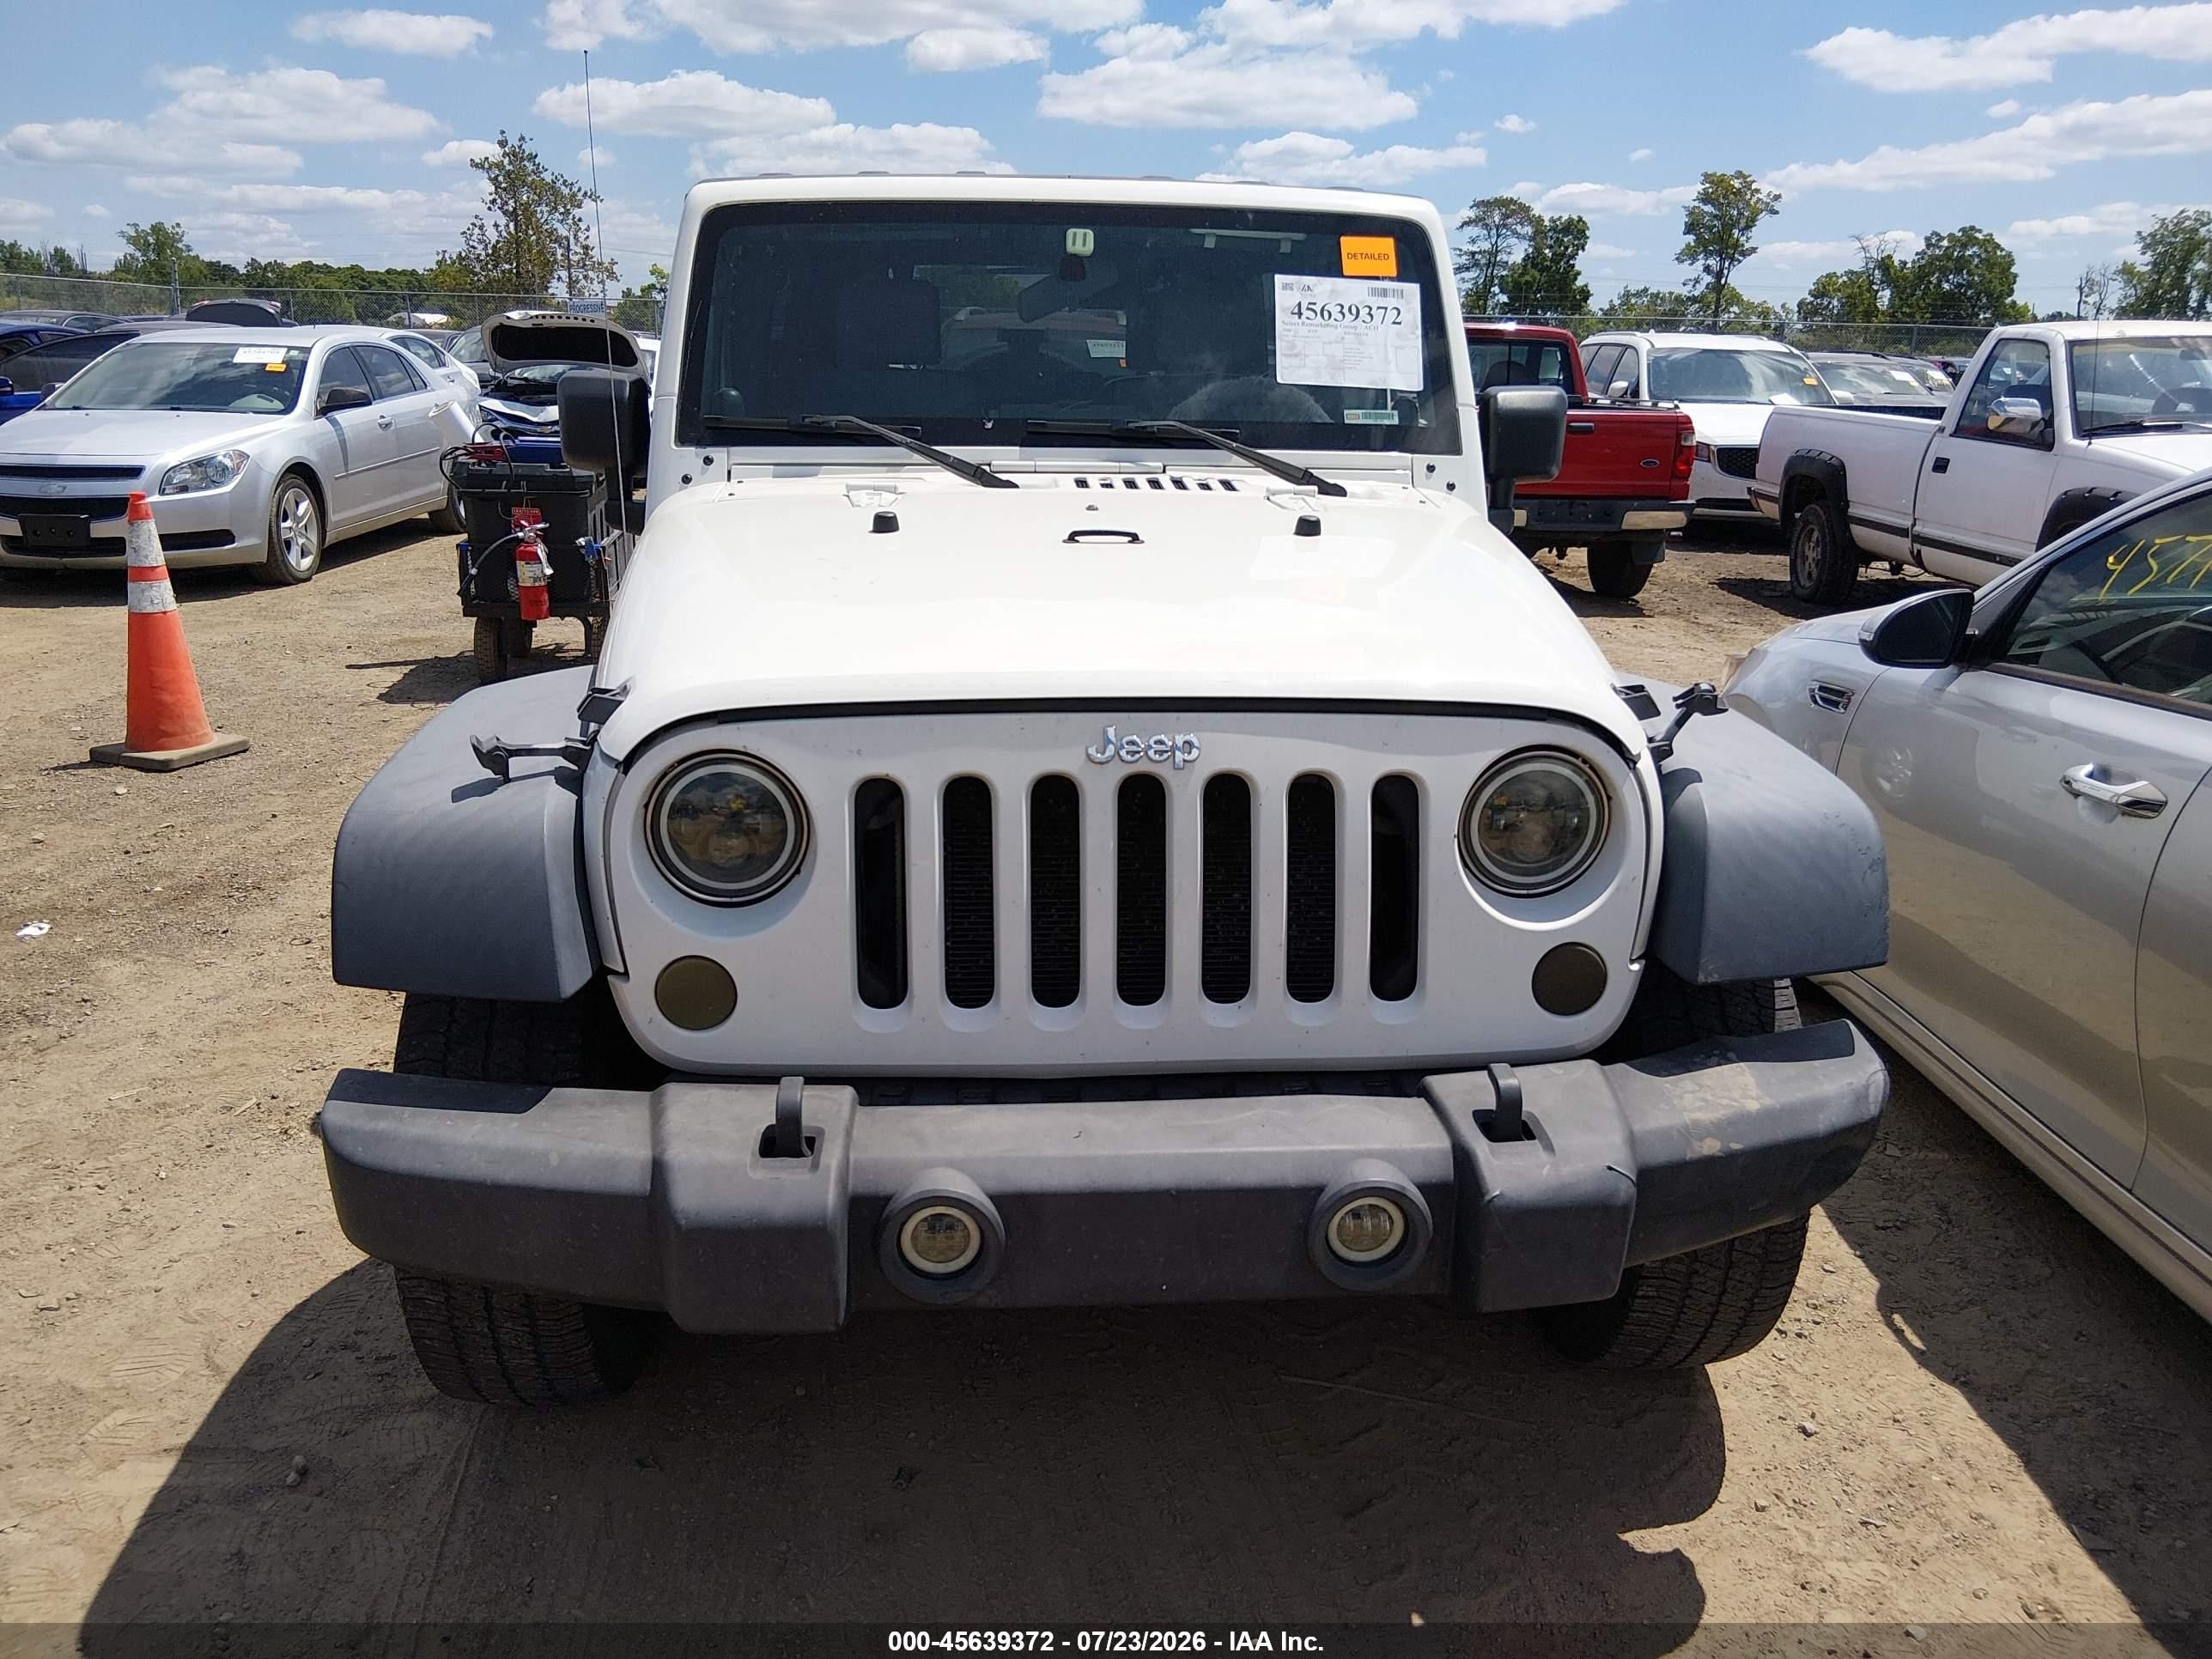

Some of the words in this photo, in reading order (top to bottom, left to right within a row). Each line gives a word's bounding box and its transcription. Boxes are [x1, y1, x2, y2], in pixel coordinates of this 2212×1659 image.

[1346, 252, 1389, 261] DETAILED
[569, 301, 605, 314] PROGRESSIVE
[1291, 301, 1402, 325] 45639372
[1085, 725, 1200, 770] Jeep
